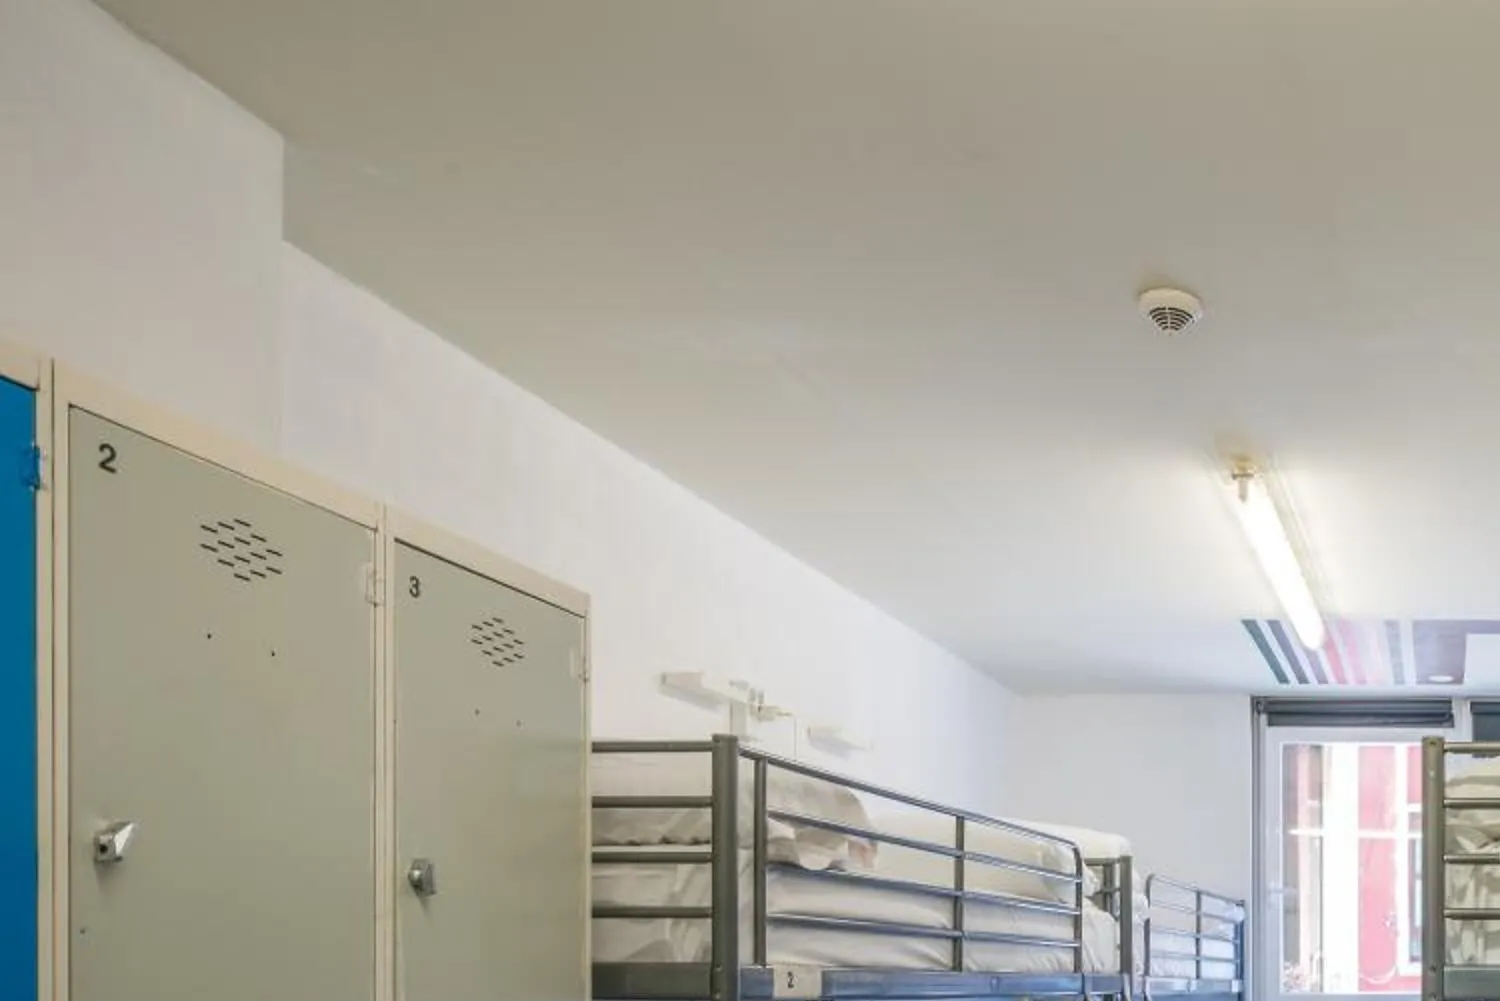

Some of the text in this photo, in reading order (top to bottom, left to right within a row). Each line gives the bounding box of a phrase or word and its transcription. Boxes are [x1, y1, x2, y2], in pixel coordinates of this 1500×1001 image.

[98, 443, 117, 474] 2
[409, 575, 421, 599] 3
[786, 971, 795, 988] 2
